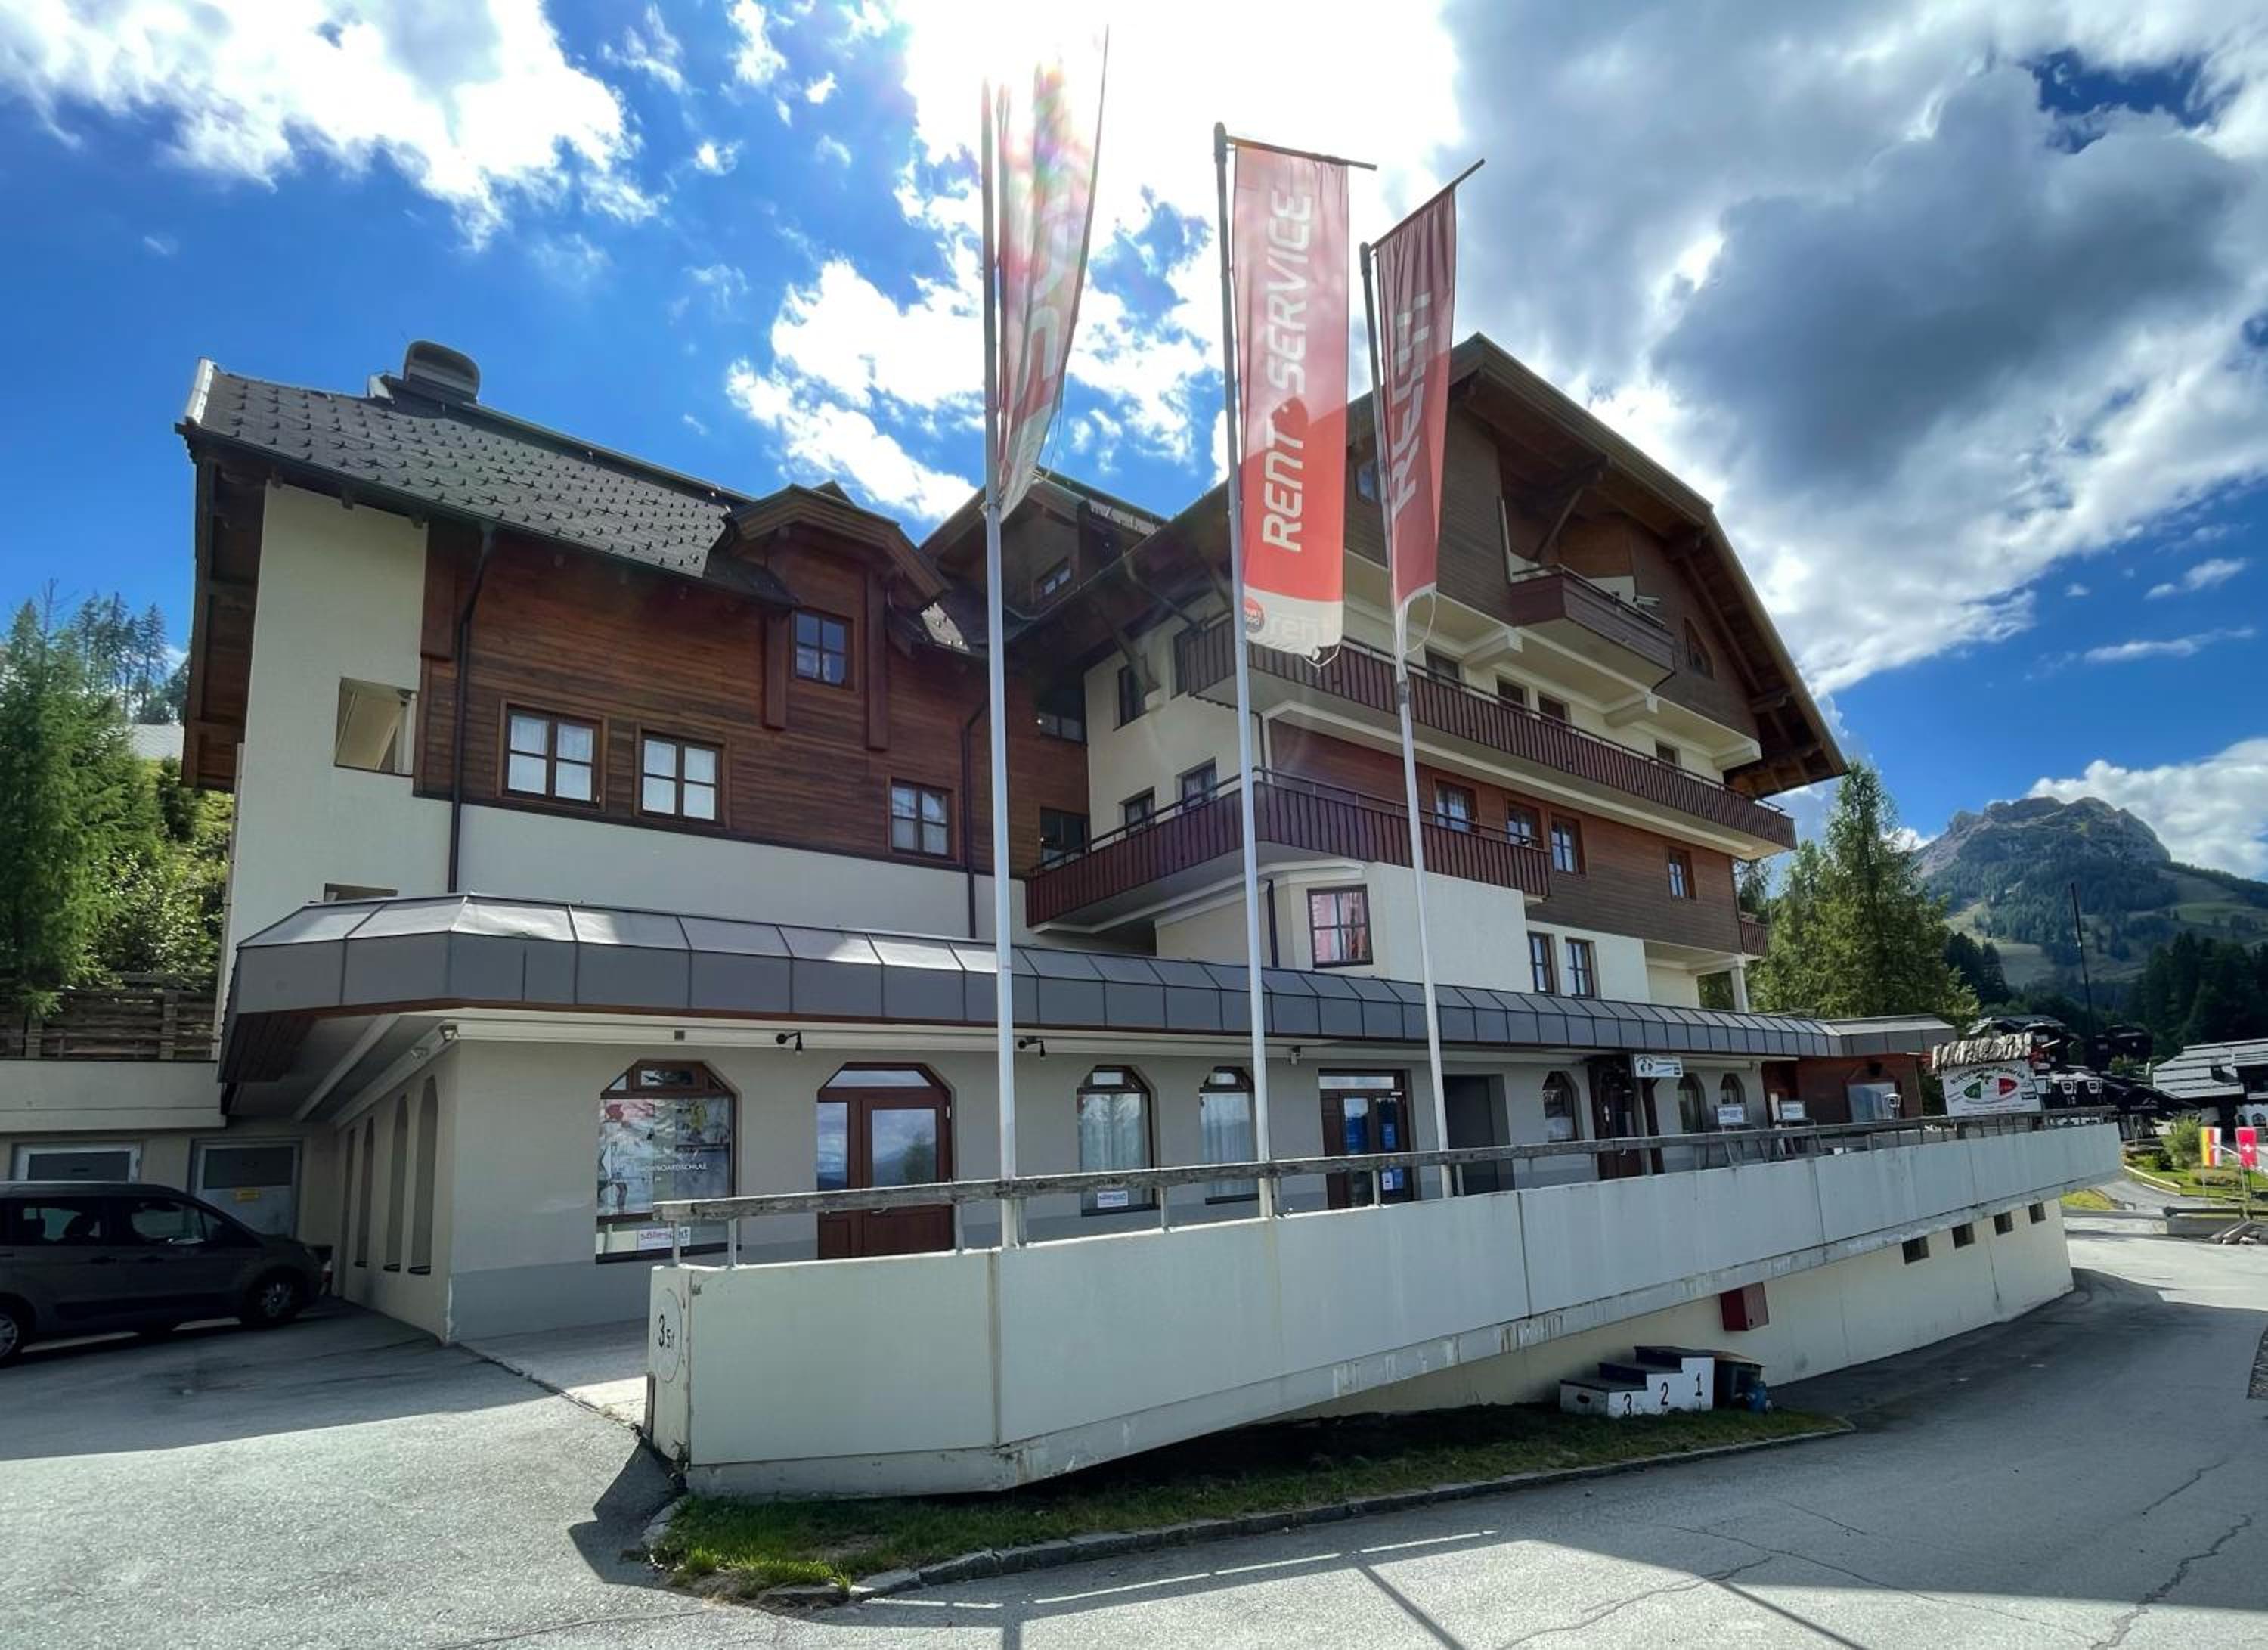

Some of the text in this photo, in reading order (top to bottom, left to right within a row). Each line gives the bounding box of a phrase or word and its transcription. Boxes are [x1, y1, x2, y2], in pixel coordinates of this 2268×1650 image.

[1262, 188, 1312, 553] RENT SERVICE
[1660, 1382, 1668, 1405] 2
[1695, 1372, 1703, 1397] 1
[1623, 1392, 1632, 1416] 3
